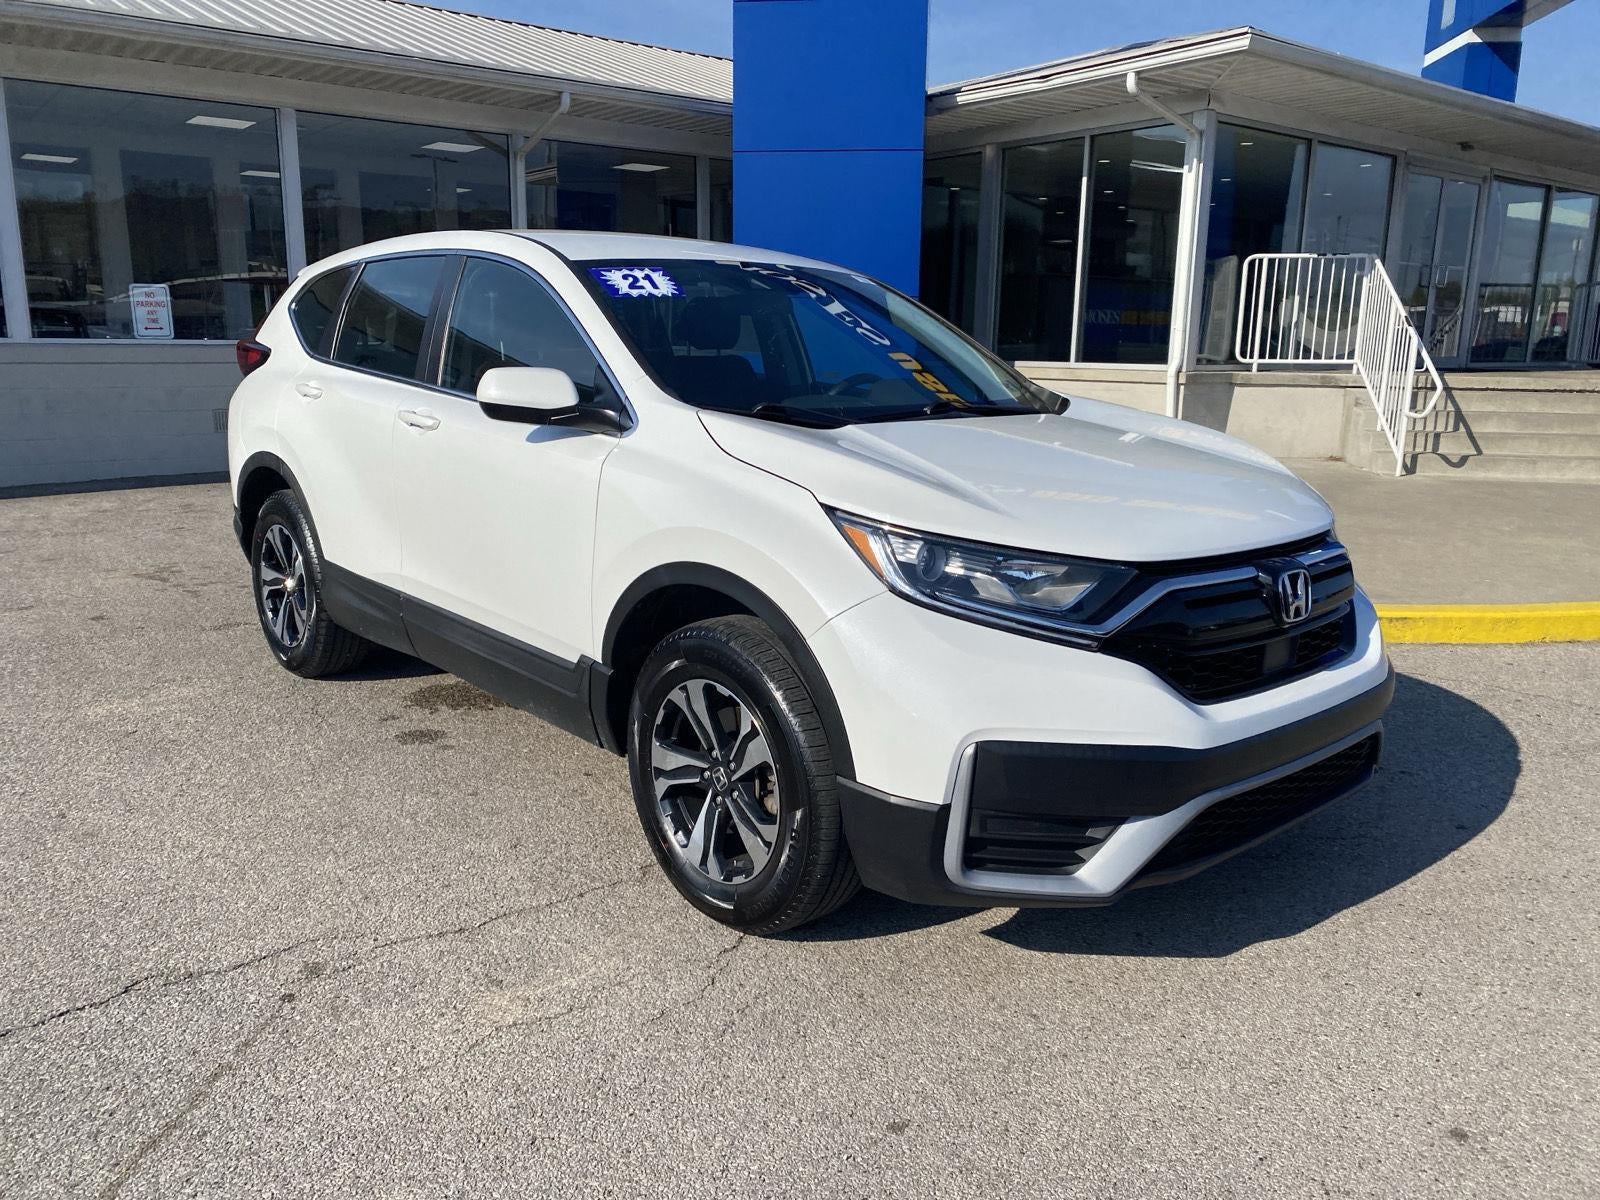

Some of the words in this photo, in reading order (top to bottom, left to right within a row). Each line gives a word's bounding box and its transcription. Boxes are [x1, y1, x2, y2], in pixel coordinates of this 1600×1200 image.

[621, 273, 660, 290] 21
[144, 291, 155, 299] NO
[135, 300, 166, 308] PARKING
